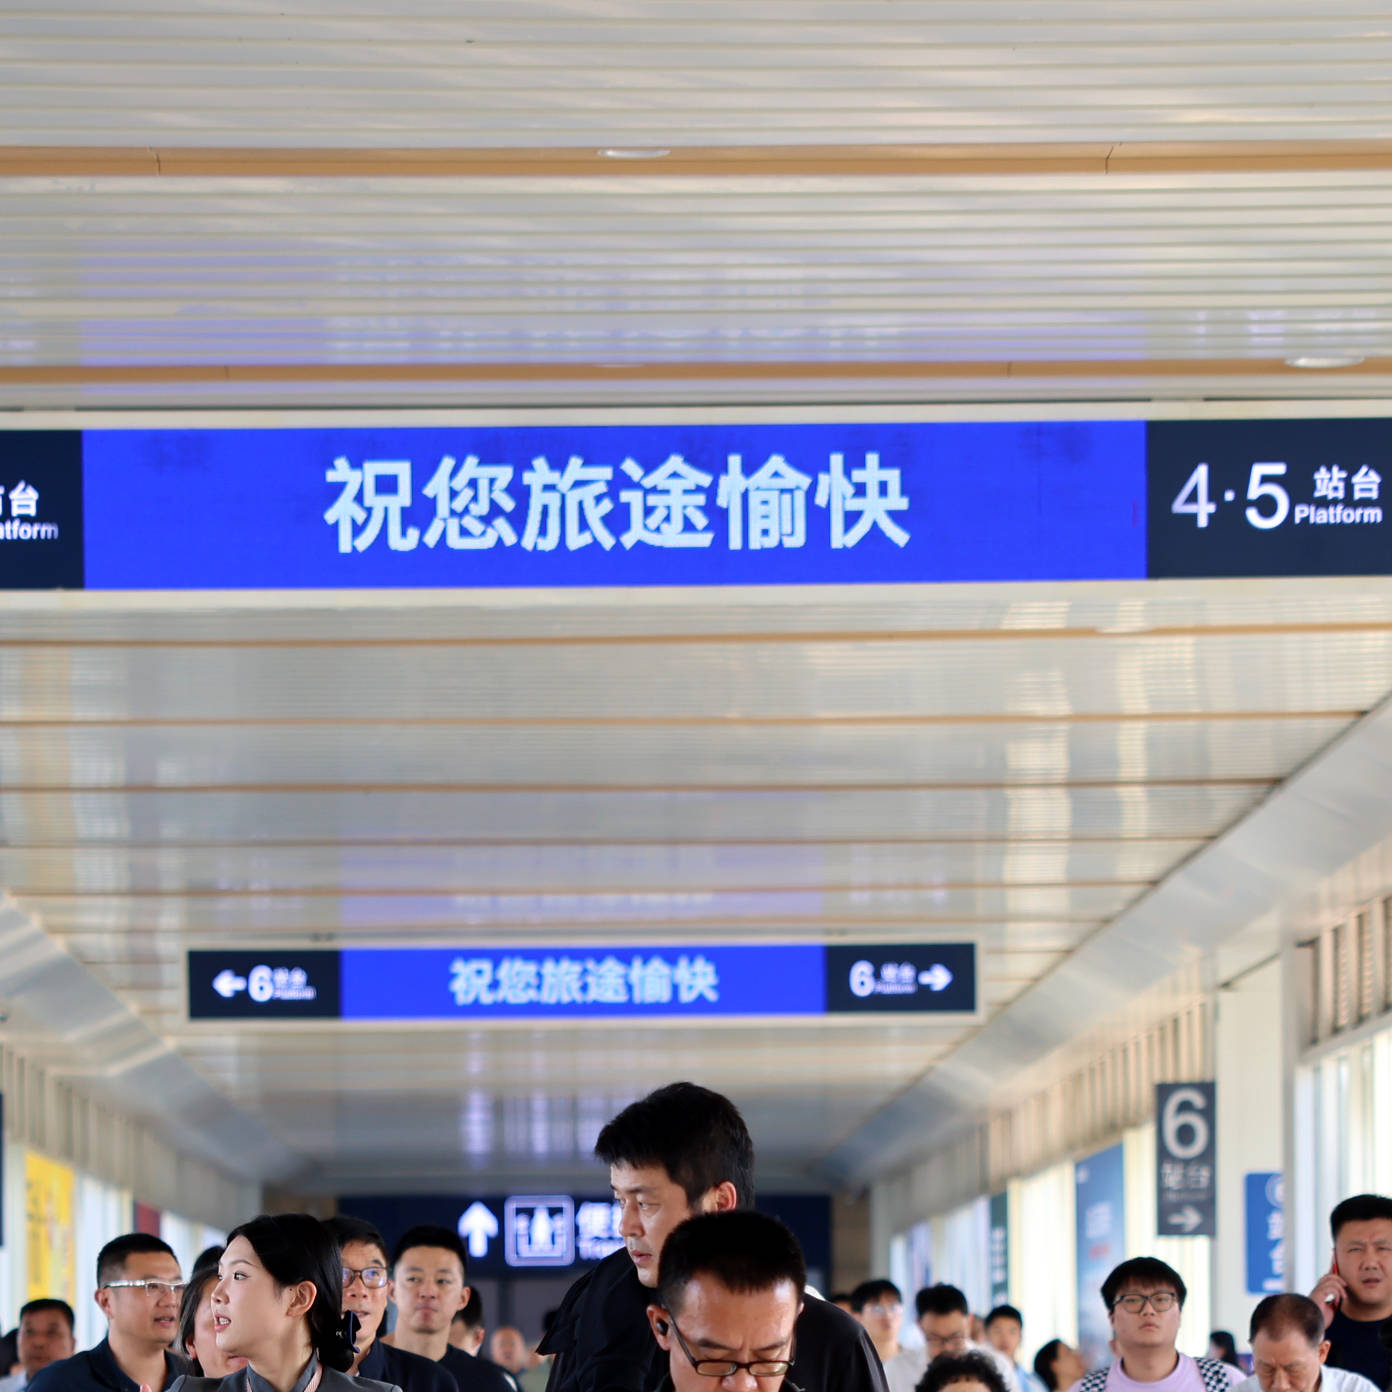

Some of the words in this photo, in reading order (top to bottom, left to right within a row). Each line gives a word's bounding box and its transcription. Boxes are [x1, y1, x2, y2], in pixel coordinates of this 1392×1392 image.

[1313, 465, 1381, 500] 站台
[324, 453, 911, 554] 祝您旅途愉快
[1294, 503, 1383, 525] Platform
[248, 965, 274, 1002] 6
[450, 956, 719, 1005] 祝您旅途愉快
[849, 960, 876, 997] 6
[1162, 1087, 1210, 1160] 6
